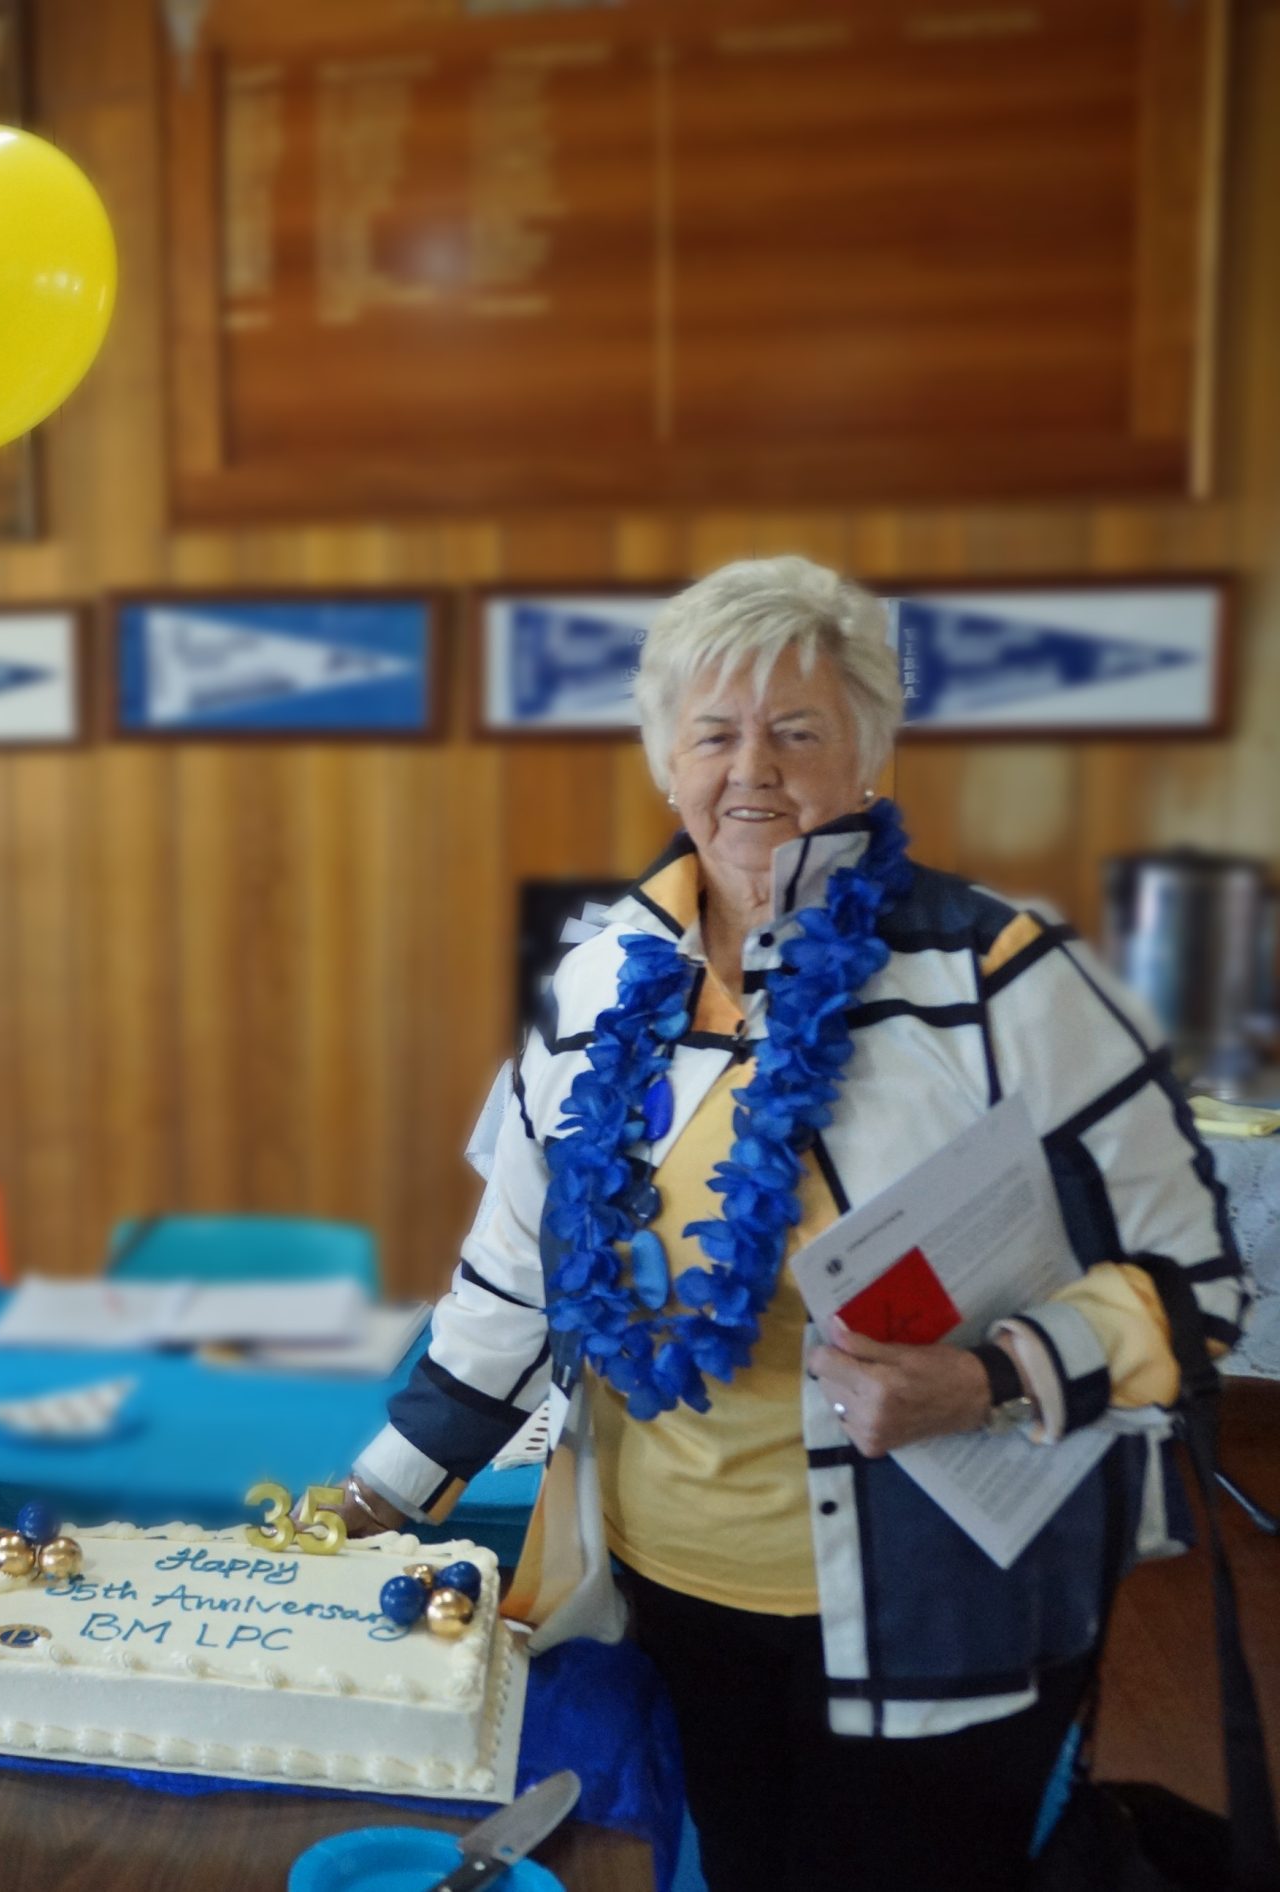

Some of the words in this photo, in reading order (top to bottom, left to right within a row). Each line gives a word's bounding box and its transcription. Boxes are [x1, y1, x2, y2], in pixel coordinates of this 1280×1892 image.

[245, 1483, 347, 1556] 35
[154, 1546, 299, 1585] Happy
[80, 1612, 173, 1645] BM
[195, 1624, 295, 1652] LPC
